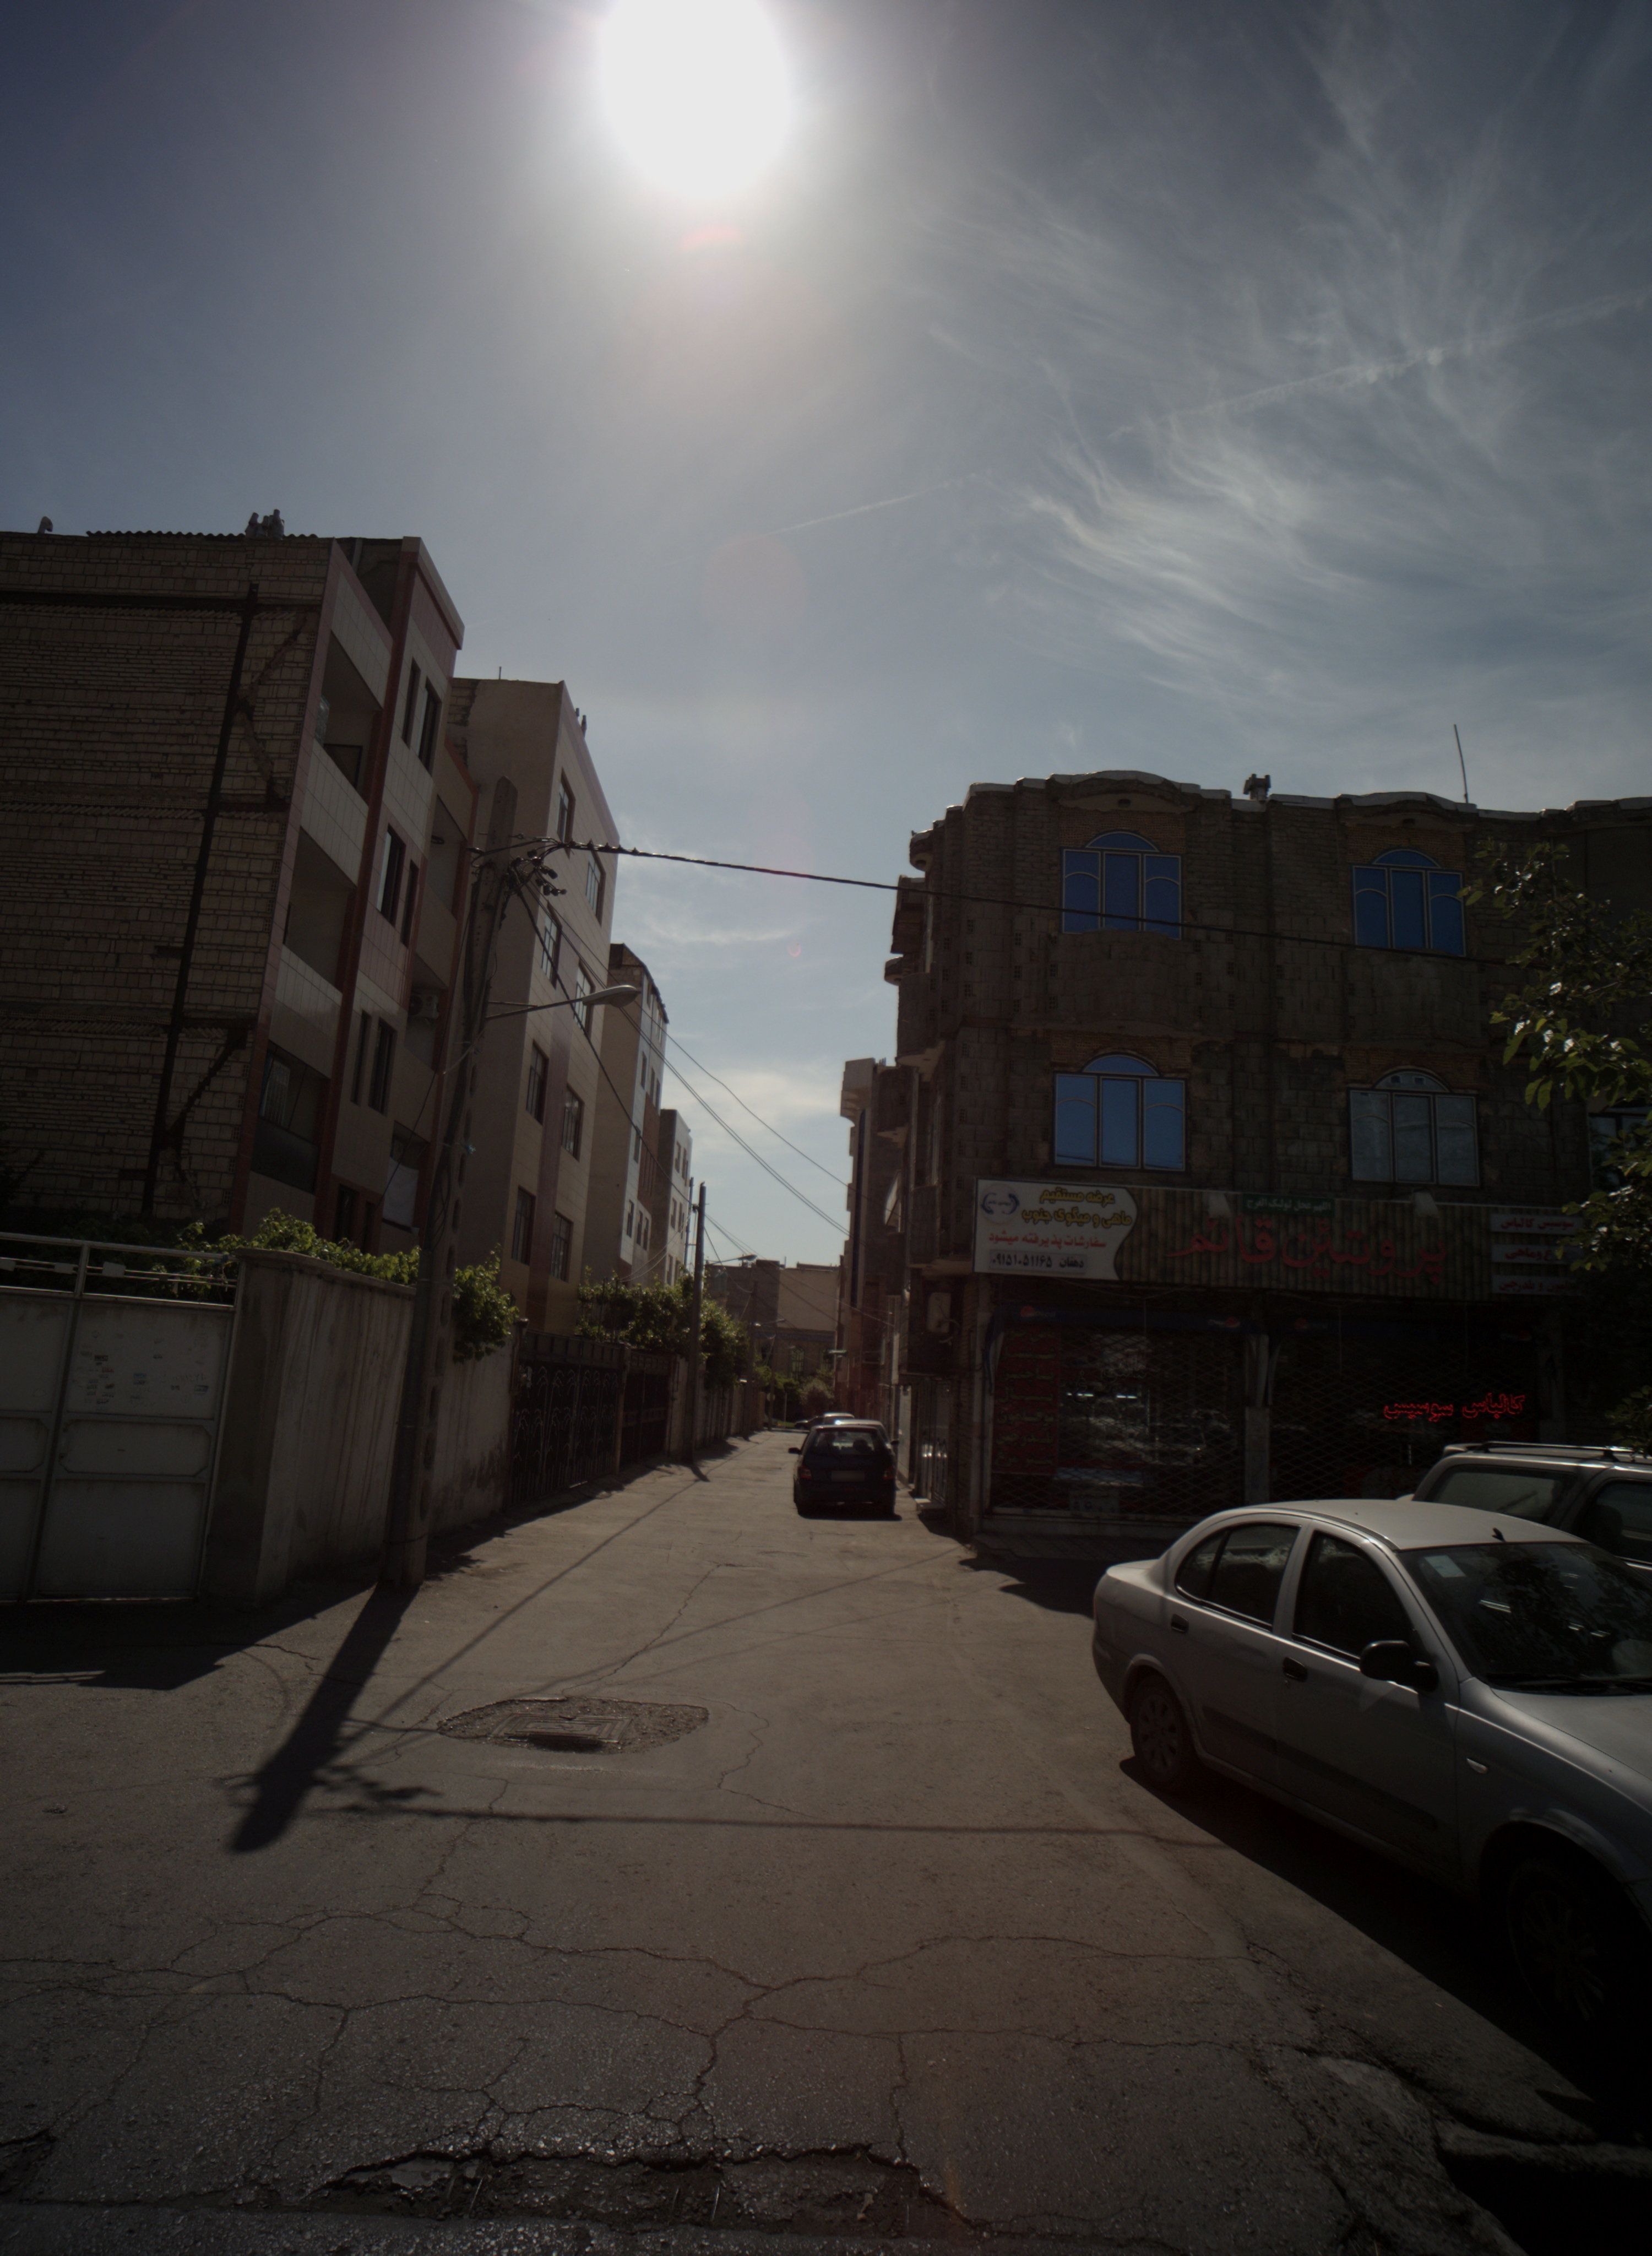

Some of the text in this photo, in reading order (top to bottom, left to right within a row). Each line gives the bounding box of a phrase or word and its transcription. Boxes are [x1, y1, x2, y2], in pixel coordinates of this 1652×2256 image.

[1040, 1186, 1115, 1207] عرضه مستقیم
[1022, 1207, 1132, 1228] ماهی و میگوی جنوب
[1064, 1235, 1106, 1249] سفارشات
[1165, 1215, 1447, 1285] پروتئین قائم
[1383, 1392, 1526, 1423] کالباس سوسیس
